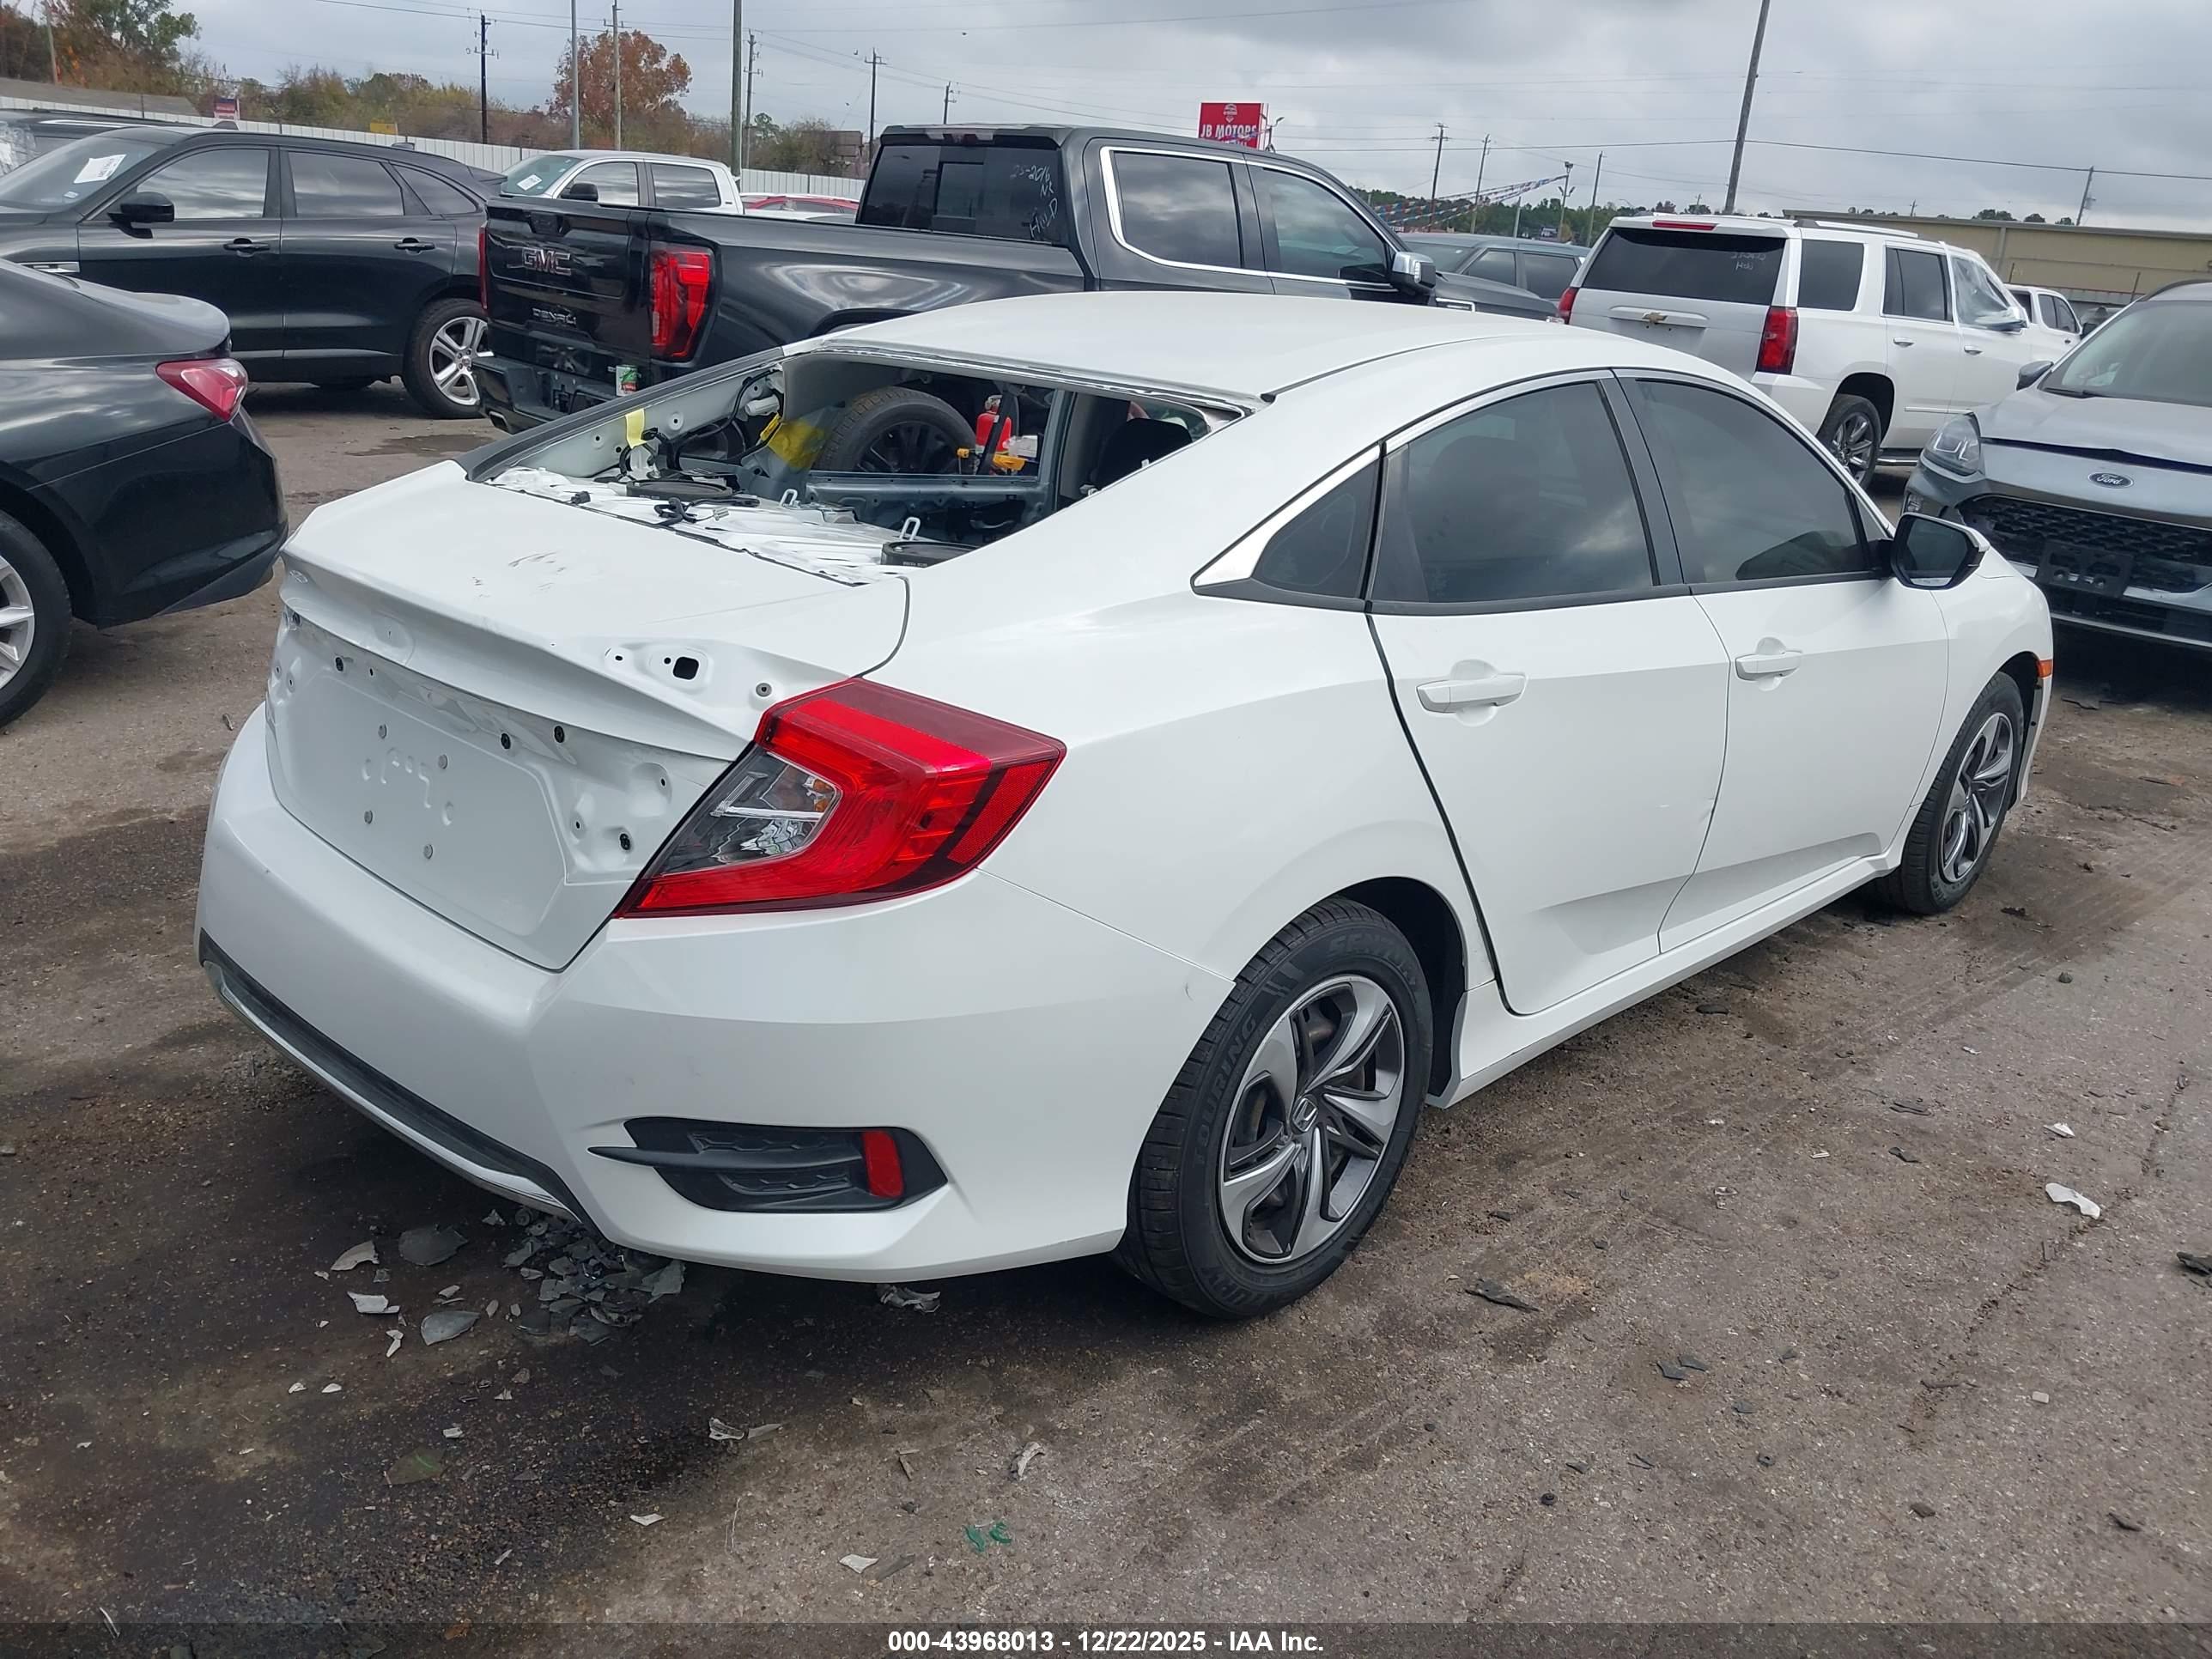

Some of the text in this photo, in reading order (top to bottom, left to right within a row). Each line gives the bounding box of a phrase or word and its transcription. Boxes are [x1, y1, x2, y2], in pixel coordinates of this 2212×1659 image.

[1200, 124, 1212, 137] JB
[521, 247, 571, 276] GMC
[2096, 473, 2124, 485] Ford
[1194, 1013, 1257, 1164] TOURING
